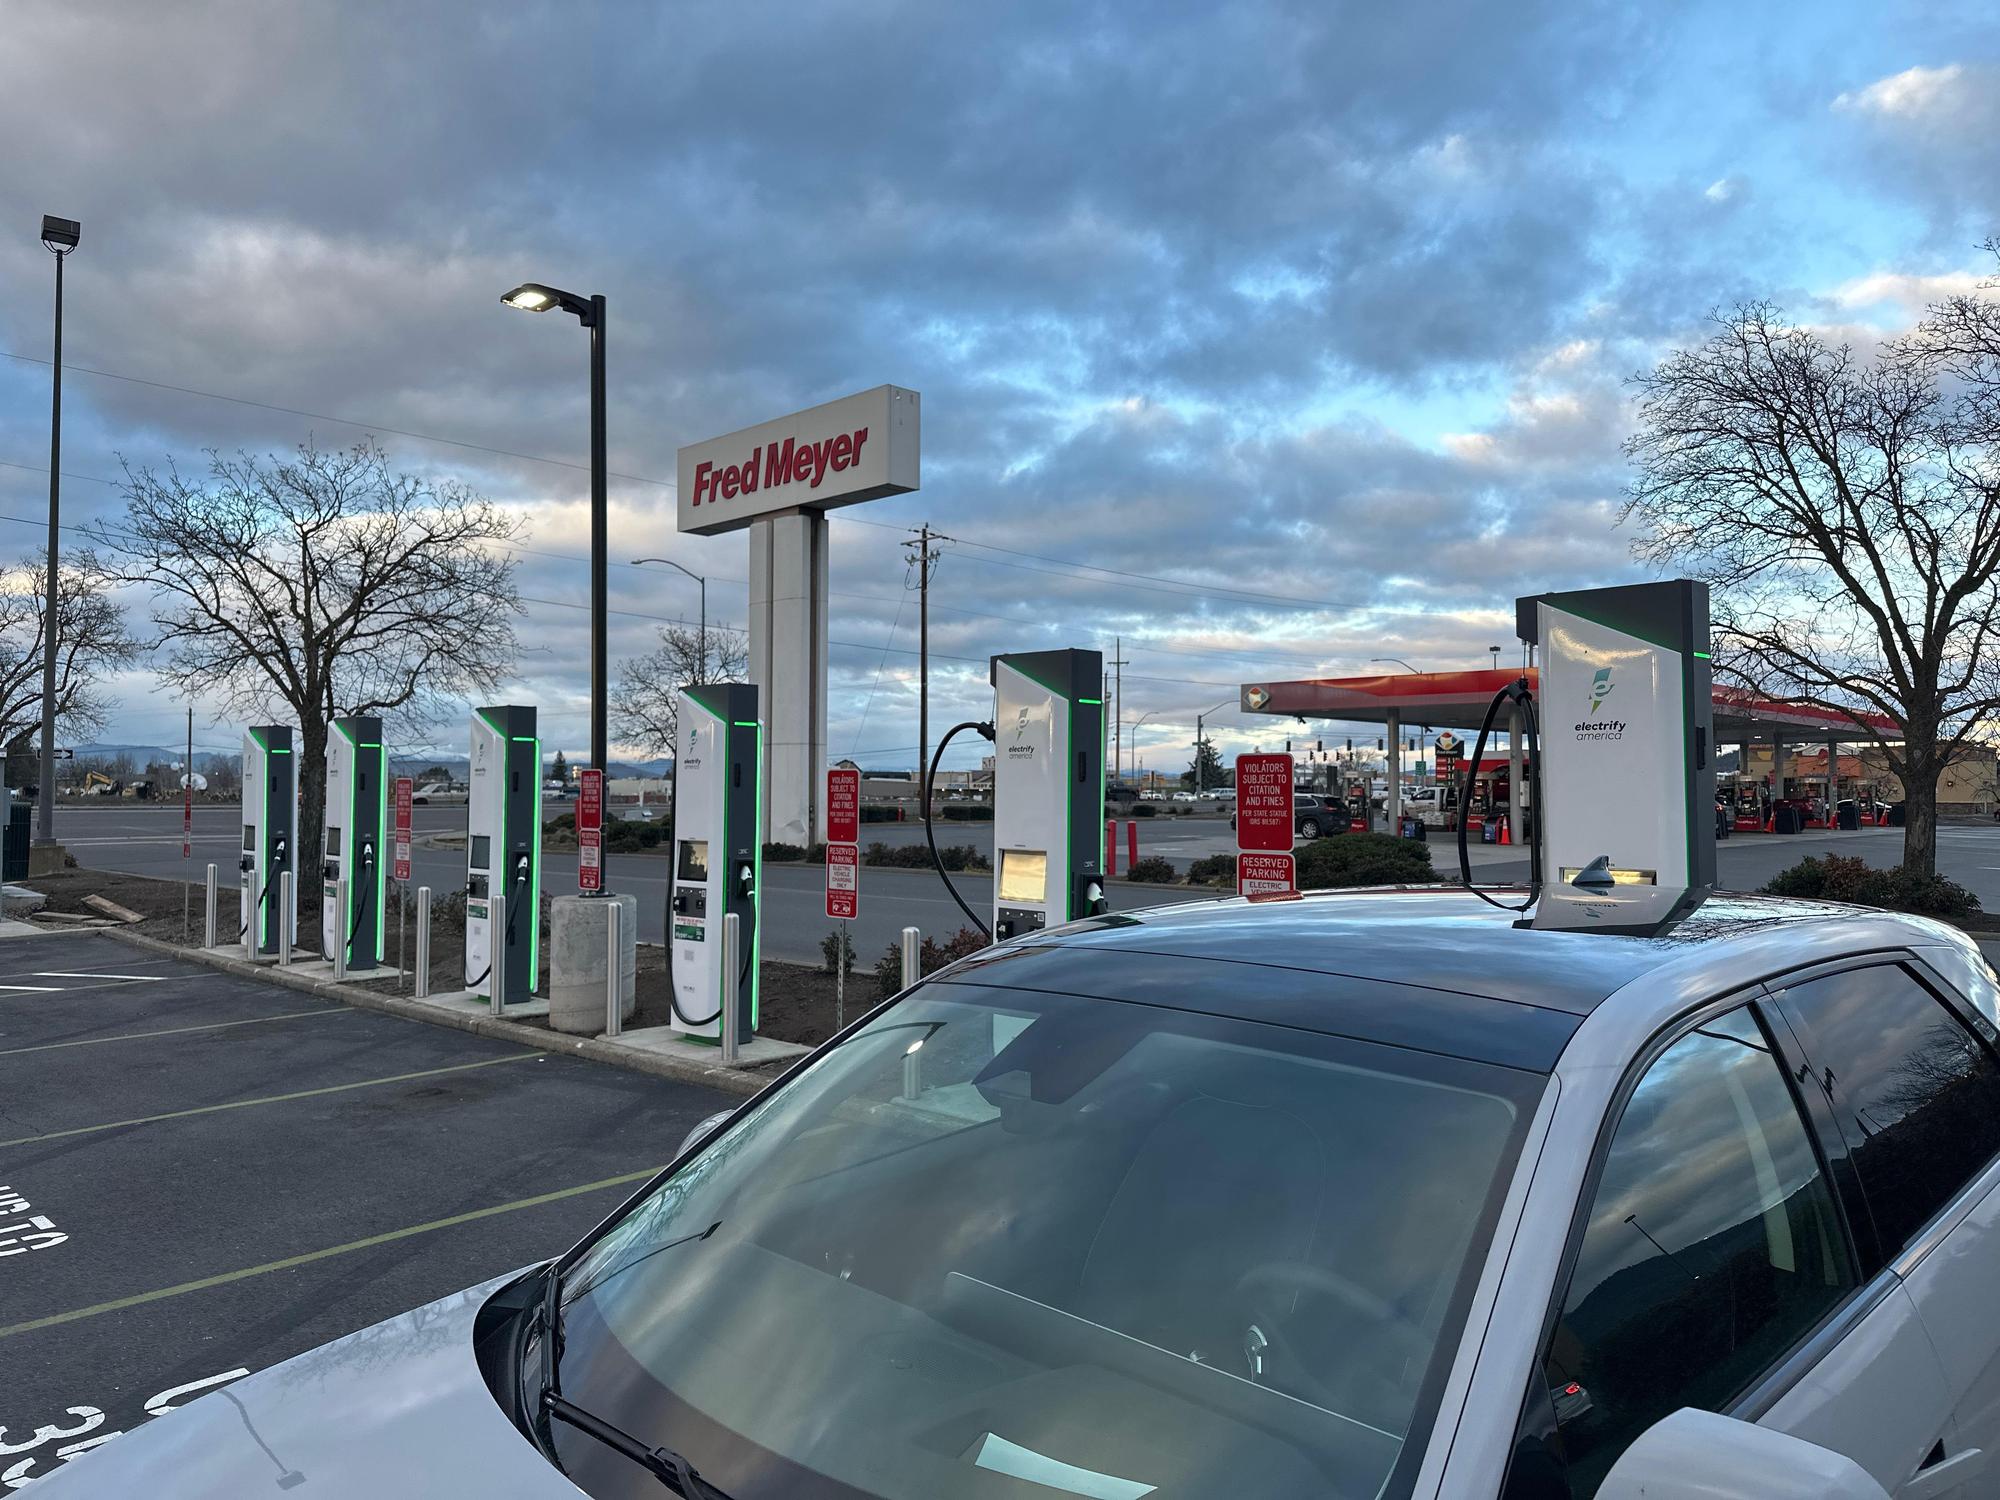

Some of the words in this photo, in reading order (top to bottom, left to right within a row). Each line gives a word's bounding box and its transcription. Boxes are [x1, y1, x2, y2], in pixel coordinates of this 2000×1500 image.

[692, 446, 762, 507] Fred
[764, 427, 869, 489] Meyer
[1574, 720, 1627, 732] electrify
[1576, 732, 1623, 741] america
[1008, 745, 1035, 753] electrify
[1244, 763, 1285, 773] VIOLATORS
[1242, 774, 1275, 784] SUBJECT
[1277, 775, 1287, 784] TO
[1248, 785, 1280, 795] CITATION
[1245, 797, 1260, 806] AND
[1263, 797, 1285, 807] FINES
[1242, 809, 1252, 817] PER
[829, 847, 856, 856] RESERVED
[831, 856, 854, 865] PARKING
[1242, 857, 1289, 868] RESERVED
[1246, 868, 1286, 879] PARKING
[1249, 881, 1282, 890] ELECTRIC
